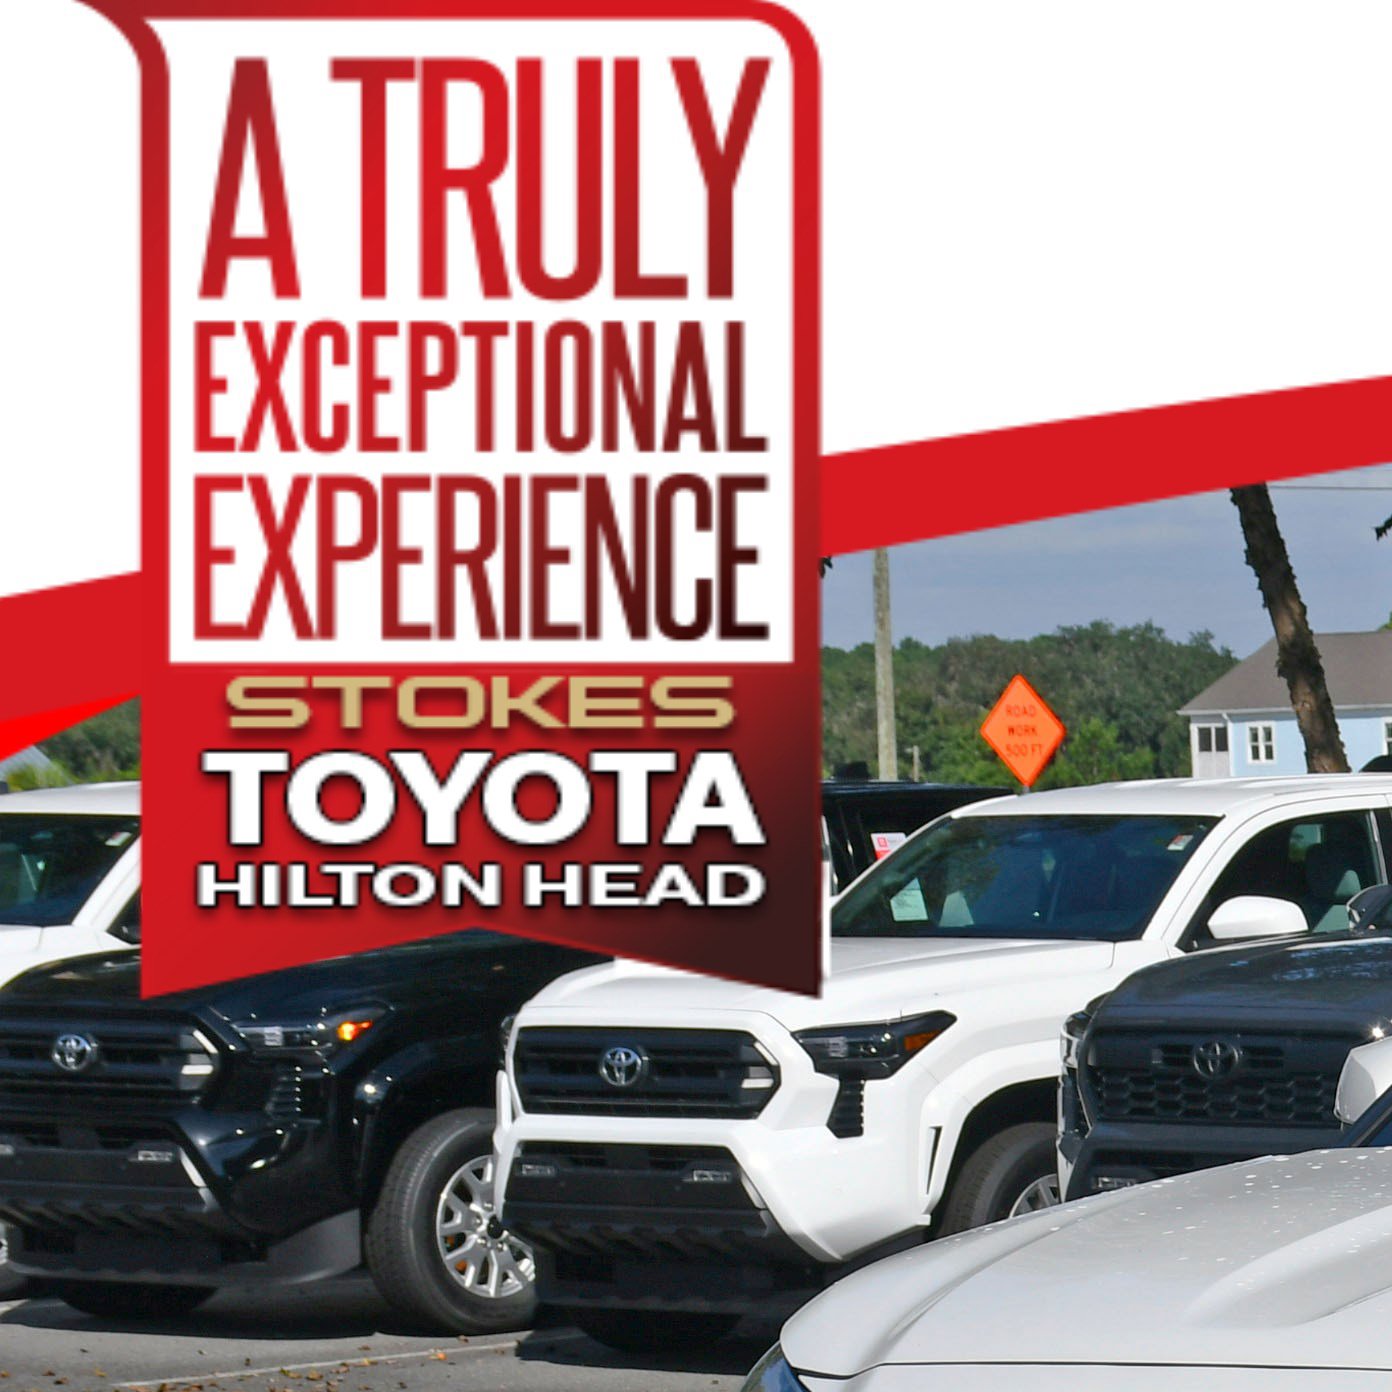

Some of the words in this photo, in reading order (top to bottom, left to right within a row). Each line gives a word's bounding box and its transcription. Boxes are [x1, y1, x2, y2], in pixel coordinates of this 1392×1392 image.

[1006, 704, 1037, 717] ROAD
[1008, 725, 1038, 737] WORK
[1006, 743, 1028, 757] 500
[1031, 743, 1042, 756] FT
